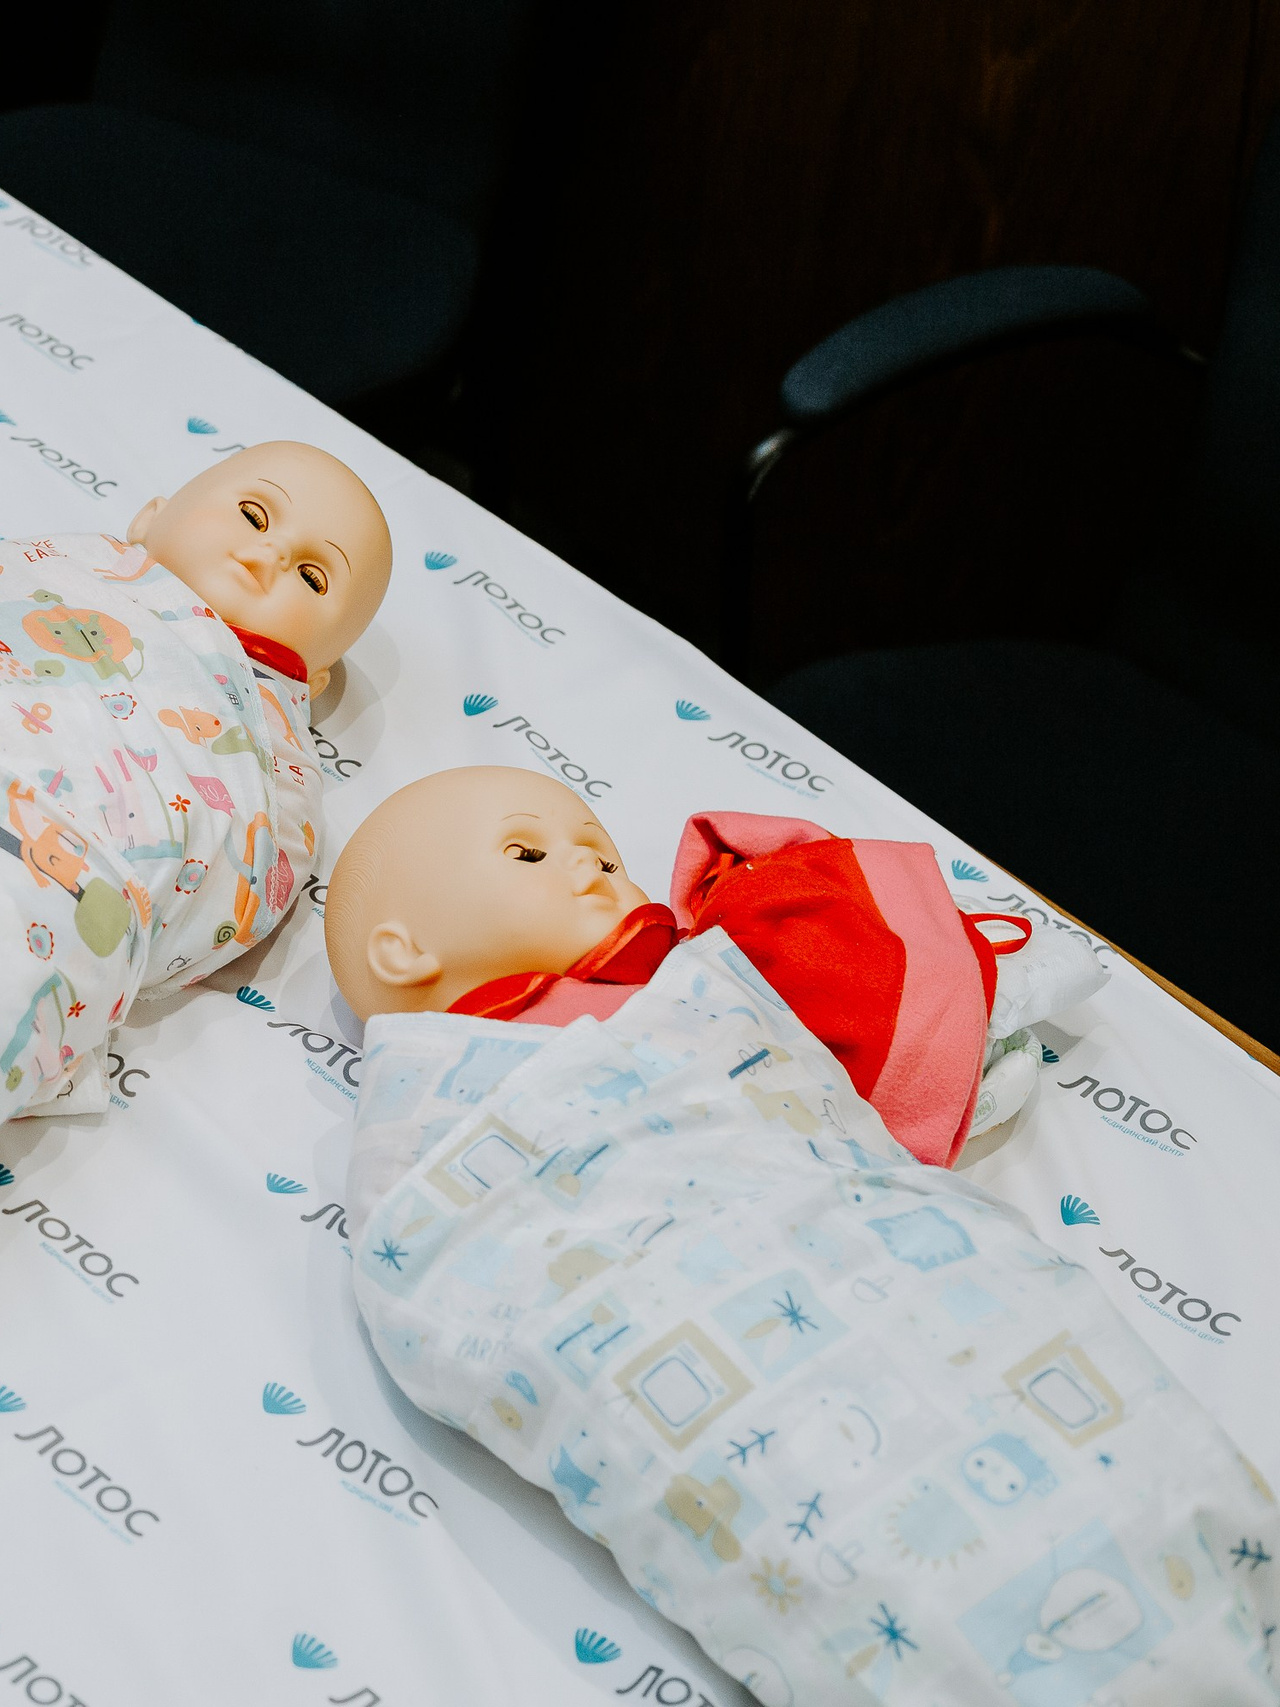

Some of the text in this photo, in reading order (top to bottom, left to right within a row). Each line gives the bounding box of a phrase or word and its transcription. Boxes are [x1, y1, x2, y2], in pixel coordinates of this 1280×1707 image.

[10, 434, 118, 499] ЛОТОС
[454, 571, 565, 645] ЛОТОС
[494, 716, 612, 798] ЛОТОС
[708, 731, 834, 793] ЛОТОС
[267, 1021, 362, 1088] ЛОТО
[303, 1057, 358, 1101] МЕДИЦИНСКИЙ
[1057, 1075, 1198, 1151] ЛОТОС
[1100, 1115, 1184, 1158] МЕДИЦИНСКИЙ ЦЕНТР
[2, 1199, 140, 1298] ЛОТОС
[1099, 1246, 1242, 1337] ЛОТОС
[1137, 1294, 1225, 1346] МЕДИЦИНСКИЙ ЦЕНТР
[15, 1426, 160, 1537] ЛОТОС
[297, 1428, 438, 1518] ЛОТОС
